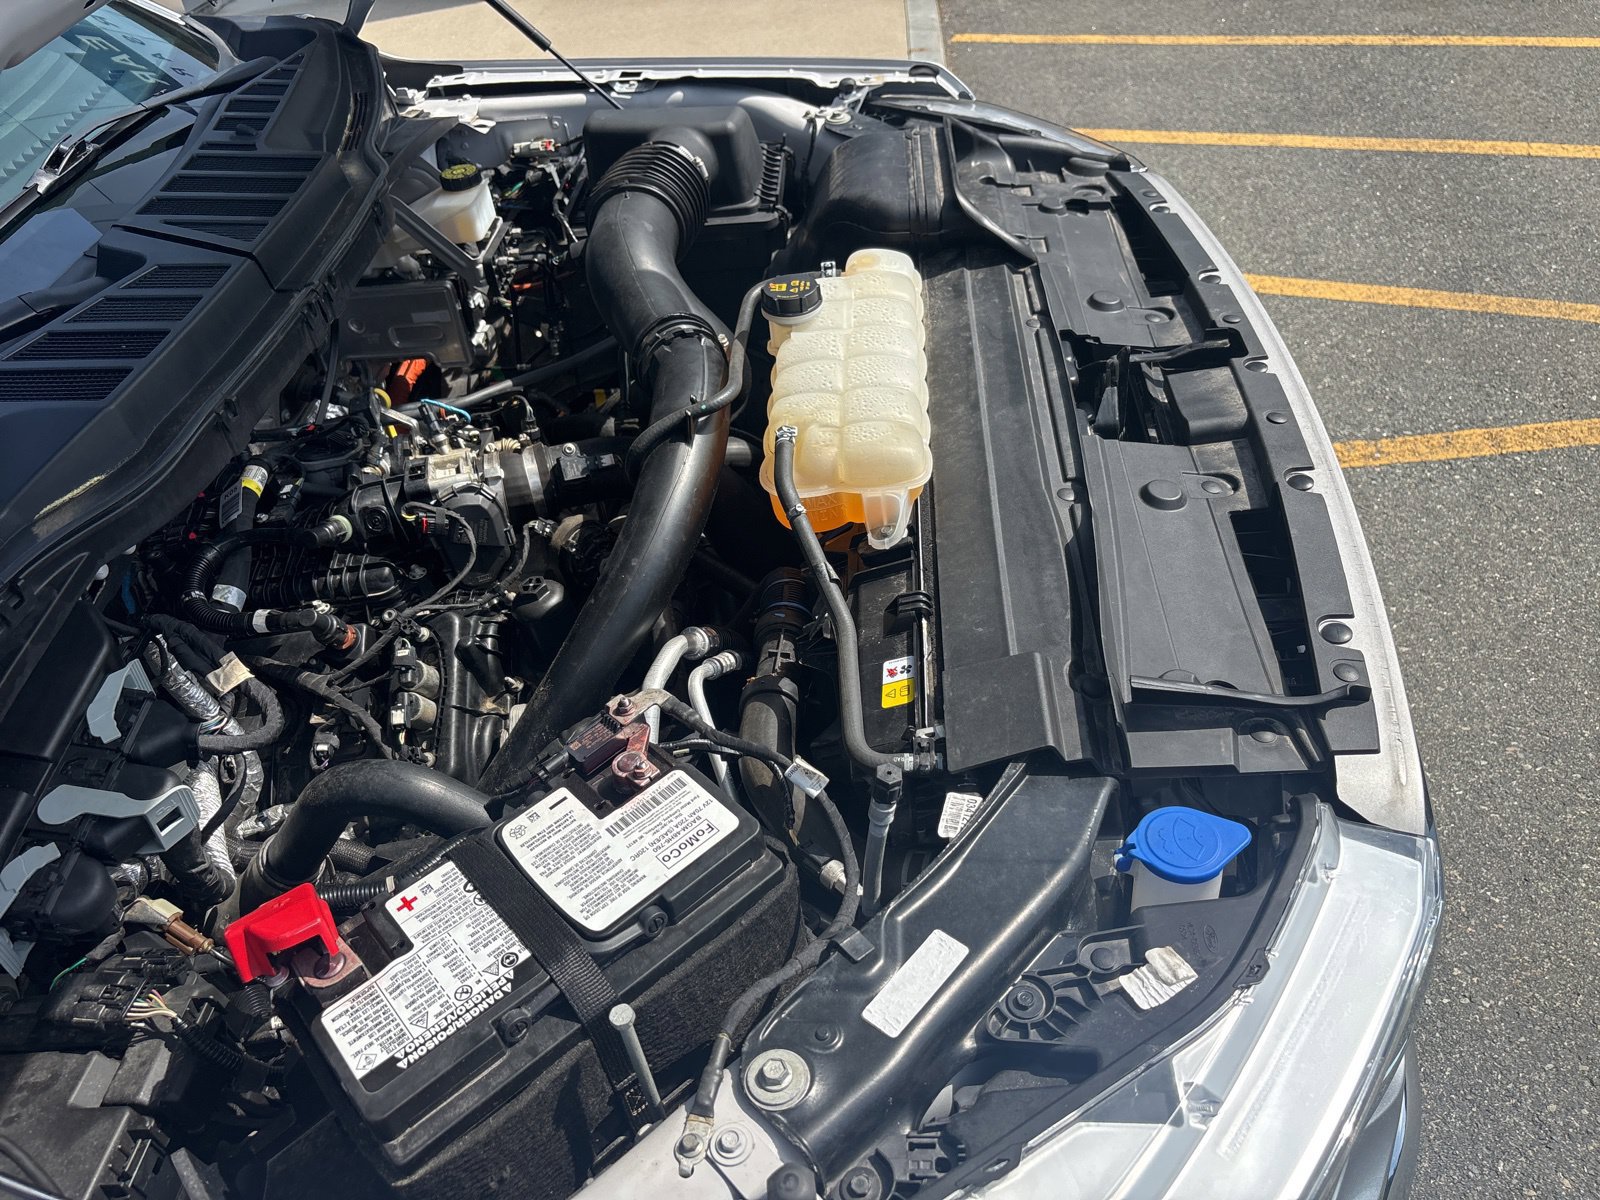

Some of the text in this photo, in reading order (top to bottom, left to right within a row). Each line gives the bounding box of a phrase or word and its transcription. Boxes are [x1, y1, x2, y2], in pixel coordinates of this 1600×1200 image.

[702, 798, 713, 808] 12V
[672, 816, 688, 828] 720A
[629, 846, 649, 861] 120RC
[661, 823, 714, 862] FoMoCo
[404, 975, 507, 1052] PELIGRO/VENENO
[406, 989, 503, 1063] DANGER/POISON
